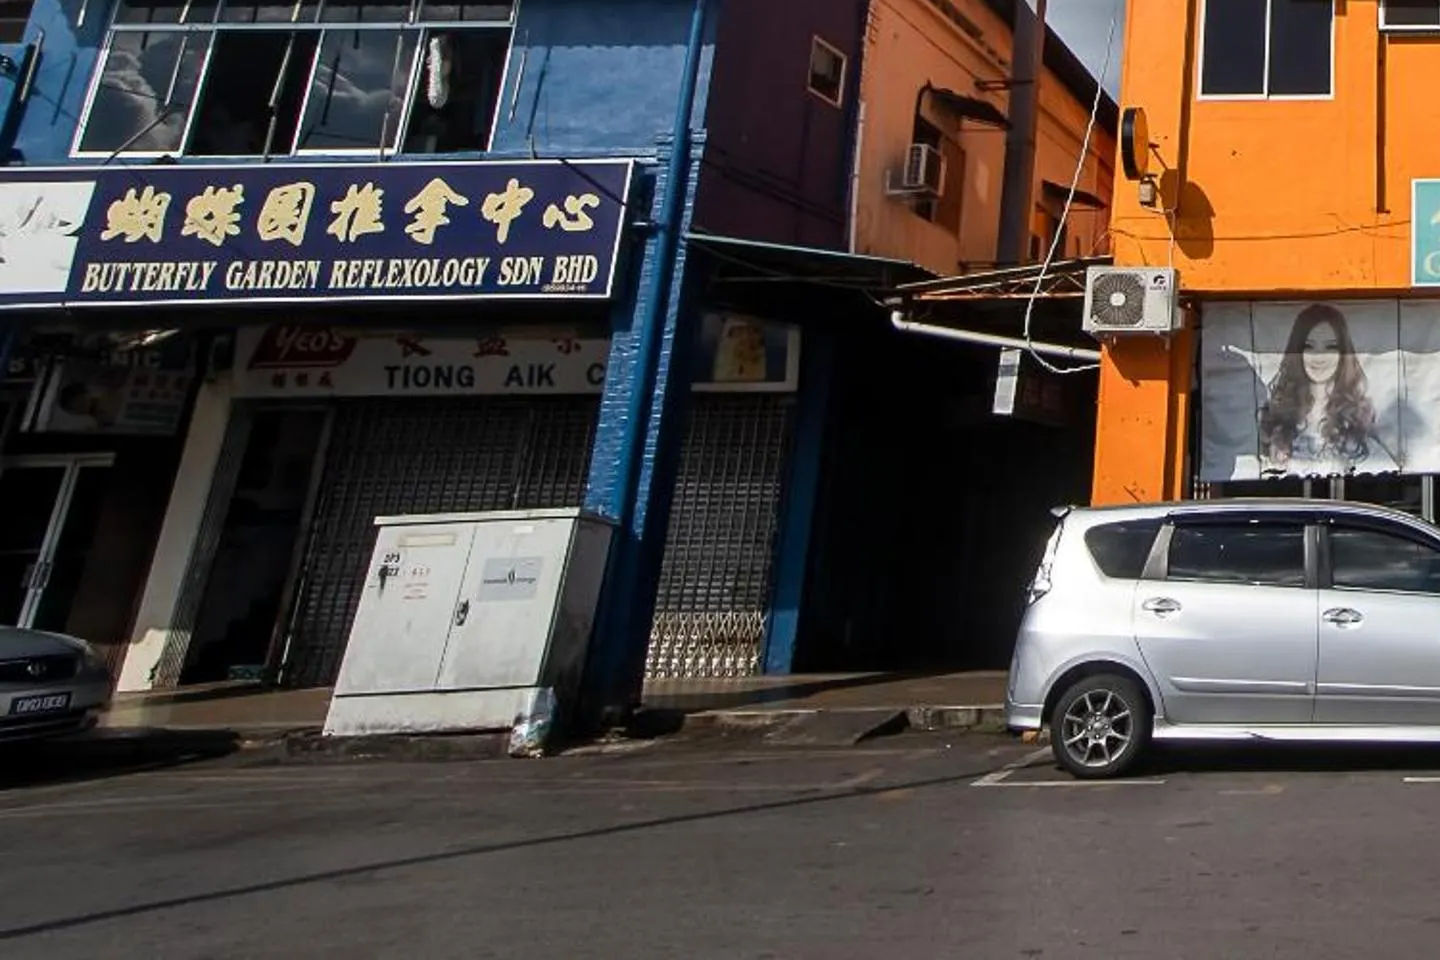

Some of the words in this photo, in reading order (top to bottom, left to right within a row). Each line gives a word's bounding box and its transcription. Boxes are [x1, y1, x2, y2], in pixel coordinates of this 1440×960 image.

[82, 262, 218, 292] BUTTERFLY
[225, 260, 322, 290] GARDEN
[328, 257, 491, 289] REFLEXOLOGY
[497, 257, 545, 286] SDN
[552, 255, 599, 284] BHD
[384, 364, 476, 389] TIONG
[504, 364, 557, 389] AIK
